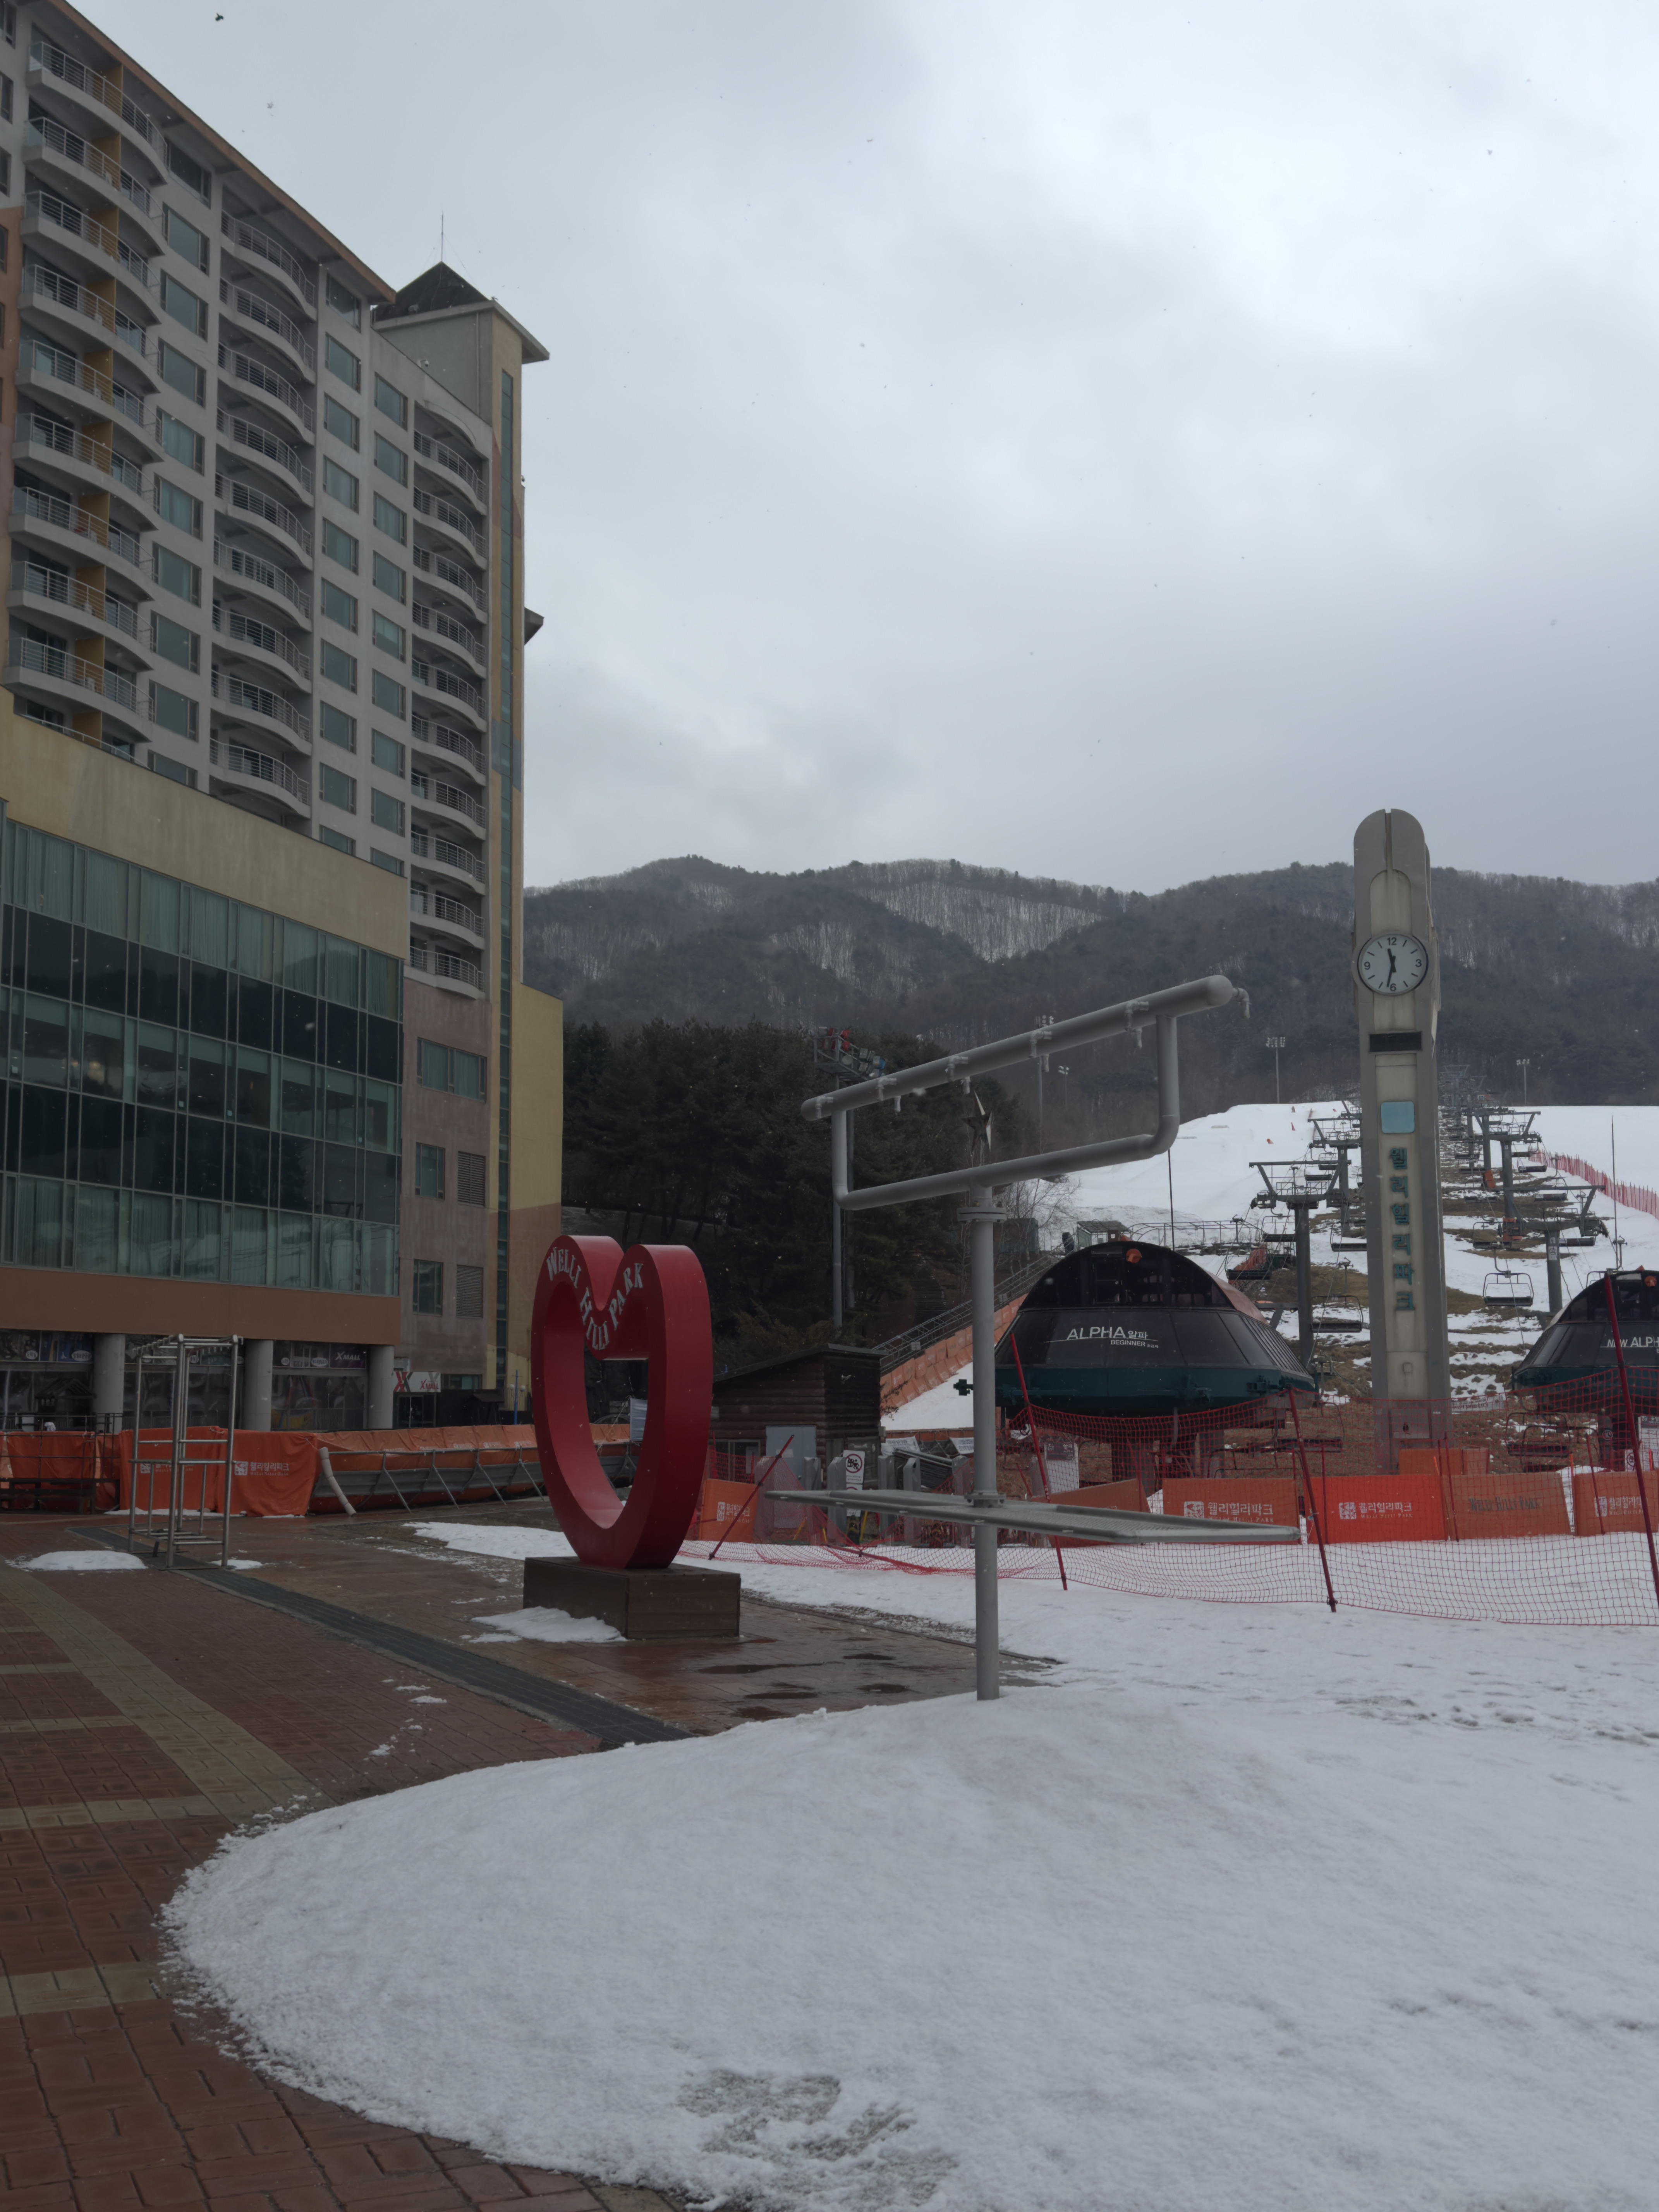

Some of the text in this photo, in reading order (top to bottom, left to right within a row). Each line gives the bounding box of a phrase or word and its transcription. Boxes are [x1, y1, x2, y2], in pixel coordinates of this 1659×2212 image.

[1387, 937, 1397, 945] 12
[1364, 959, 1422, 970] 9 3
[1389, 983, 1396, 991] 6
[1388, 1147, 1415, 1311] 웰리힐리파크
[546, 1247, 644, 1351] WELLI HILLI PARK
[1066, 1326, 1148, 1340] ALPHA 알파
[1607, 1339, 1628, 1347] NW
[1207, 1502, 1274, 1516] 웰리힐리파크
[1358, 1502, 1413, 1513] 웰리힐리파크
